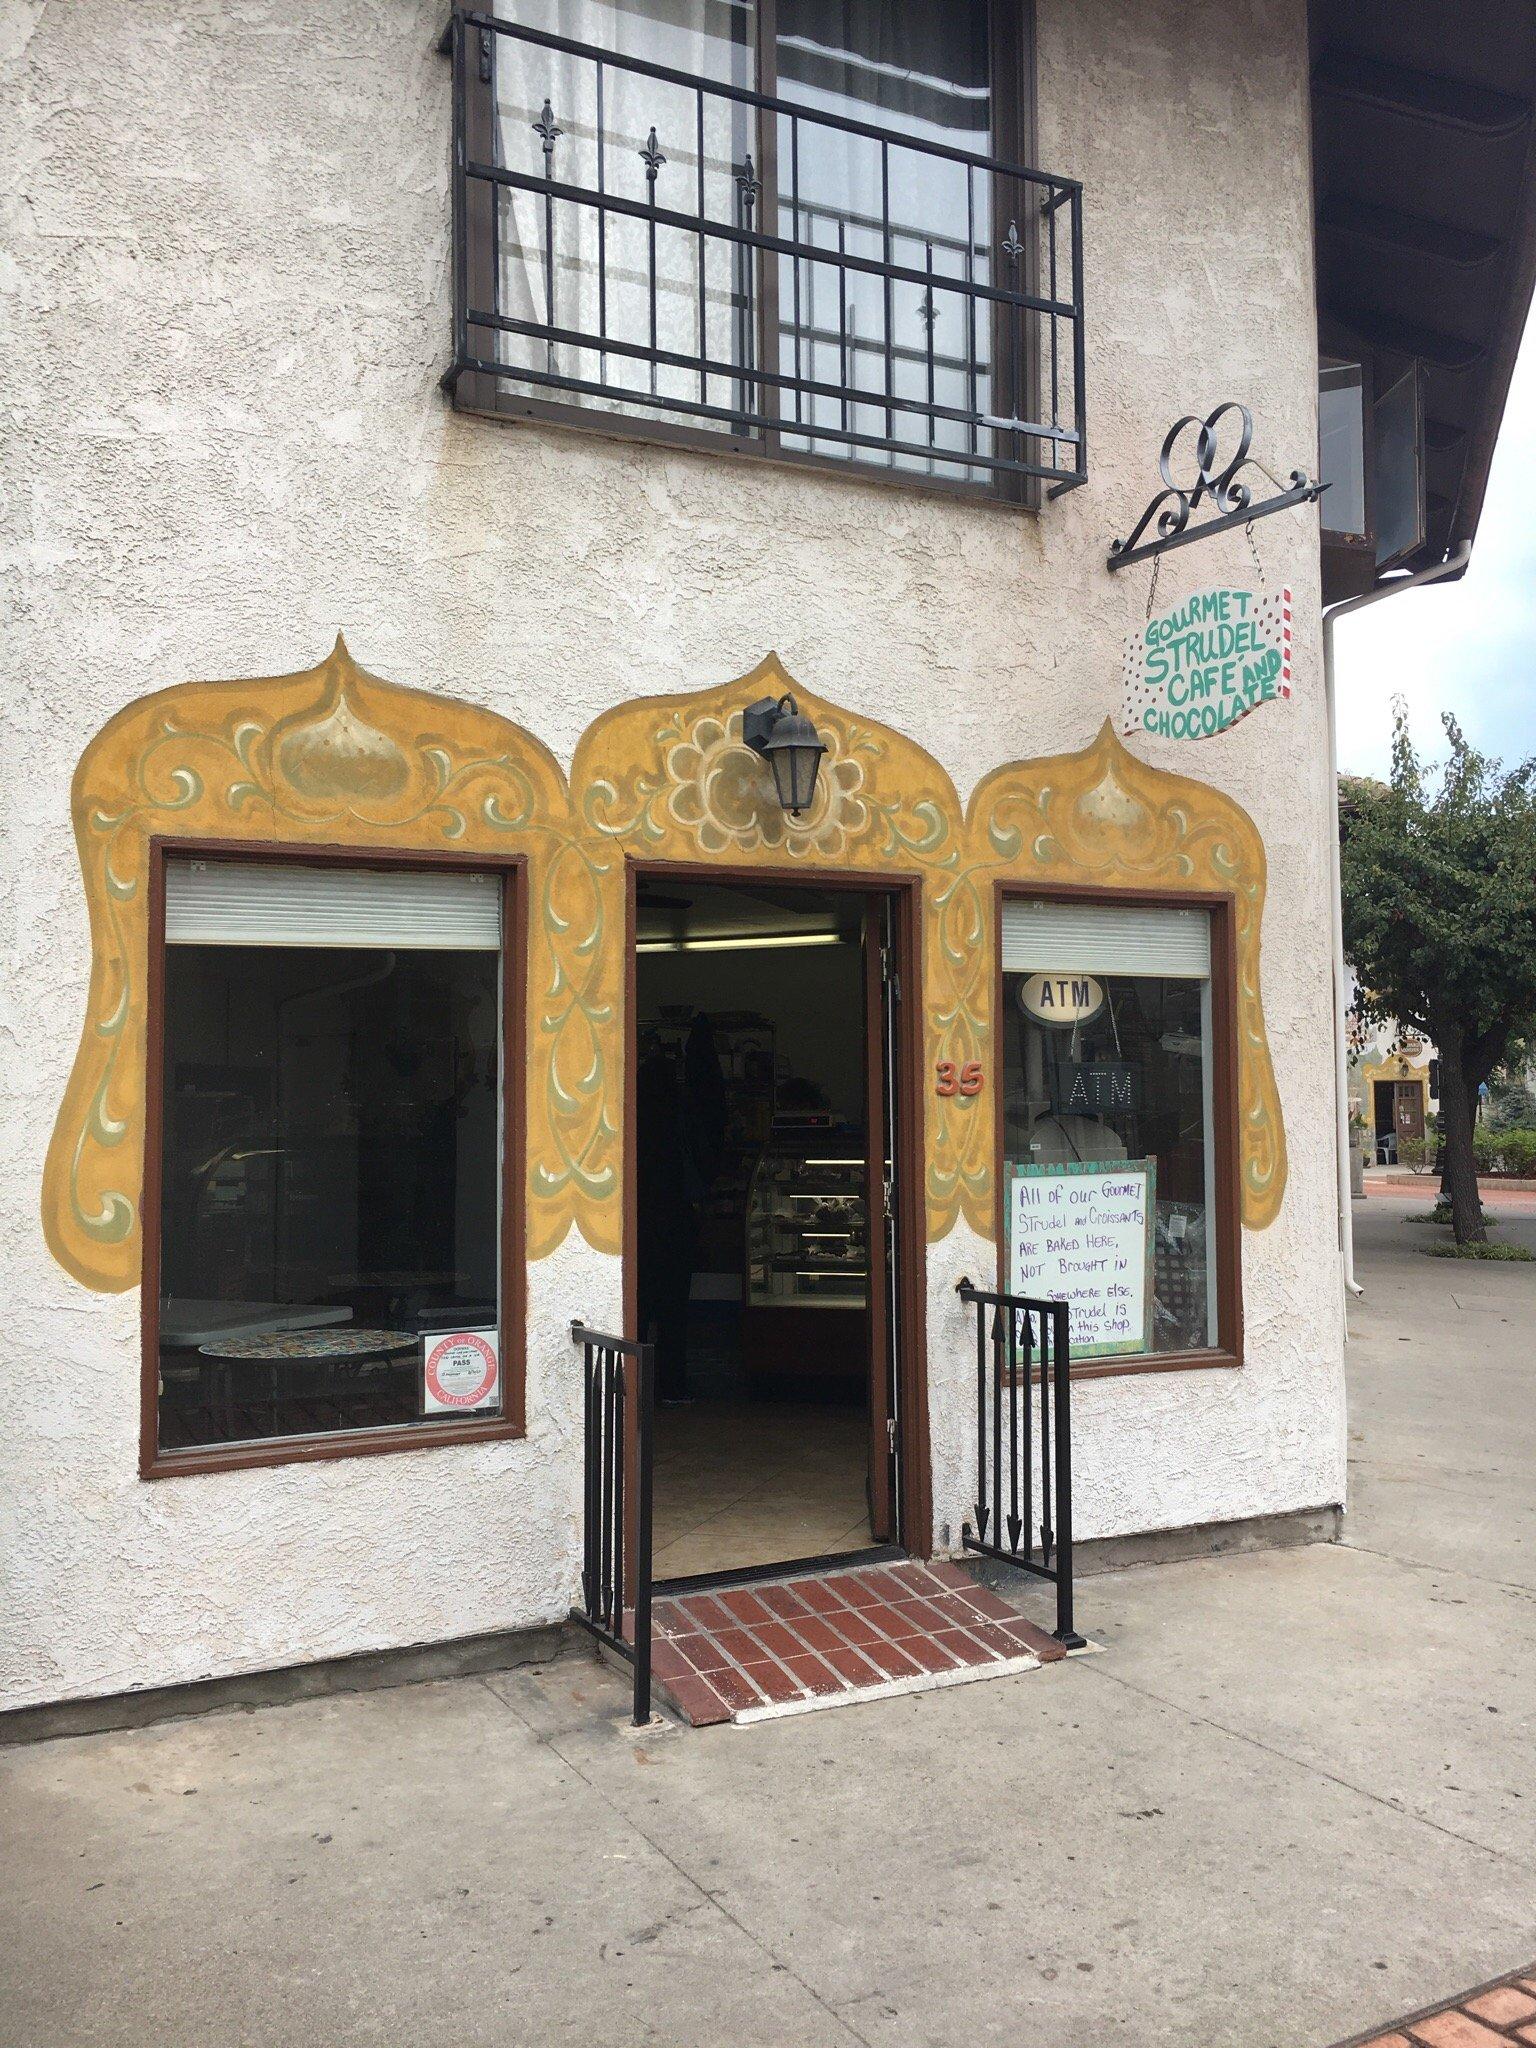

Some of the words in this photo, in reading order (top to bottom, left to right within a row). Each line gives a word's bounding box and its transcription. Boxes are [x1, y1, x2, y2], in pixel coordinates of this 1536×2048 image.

[1145, 591, 1253, 647] GOURMET
[1144, 621, 1266, 685] STRUDEL
[1242, 649, 1283, 687] AND
[1143, 675, 1277, 739] CHOCOLATE
[1040, 980, 1090, 1007] ATM
[936, 1060, 985, 1096] 35
[1069, 1072, 1131, 1105] ATM
[1020, 1185, 1041, 1207] All
[1048, 1183, 1063, 1204] of
[1069, 1190, 1097, 1205] our
[1019, 1241, 1040, 1258] ARE
[1046, 1236, 1080, 1253] BAKED
[1020, 1262, 1046, 1283] NOT
[1077, 1320, 1099, 1332] this
[428, 1338, 454, 1375] COUNTY
[468, 1337, 495, 1367] ORANGE
[438, 1386, 487, 1404] CALIFORNIA
